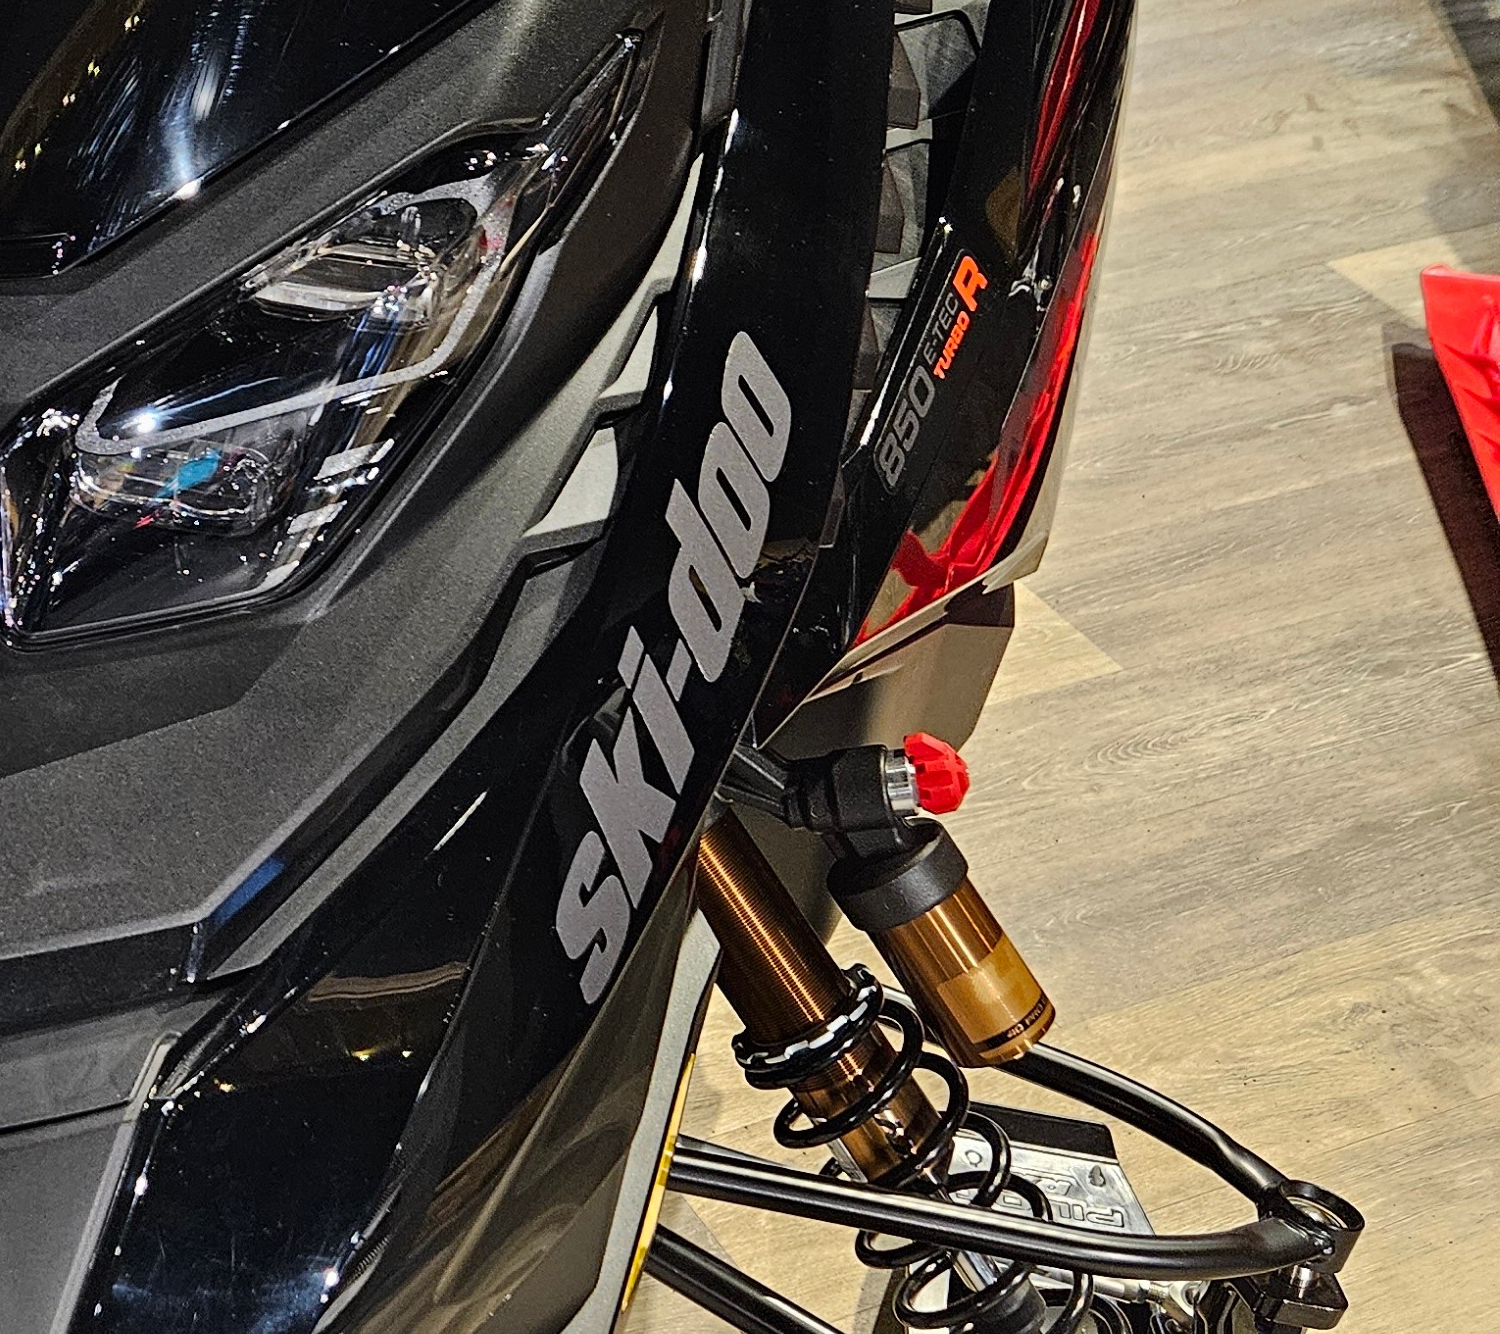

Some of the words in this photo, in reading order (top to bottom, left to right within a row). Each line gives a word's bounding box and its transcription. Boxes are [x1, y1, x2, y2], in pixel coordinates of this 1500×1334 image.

[933, 310, 971, 380] TURBO
[953, 255, 989, 312] R
[879, 365, 936, 488] 850
[923, 291, 960, 366] E-TEC
[556, 331, 792, 1005] ski-doo
